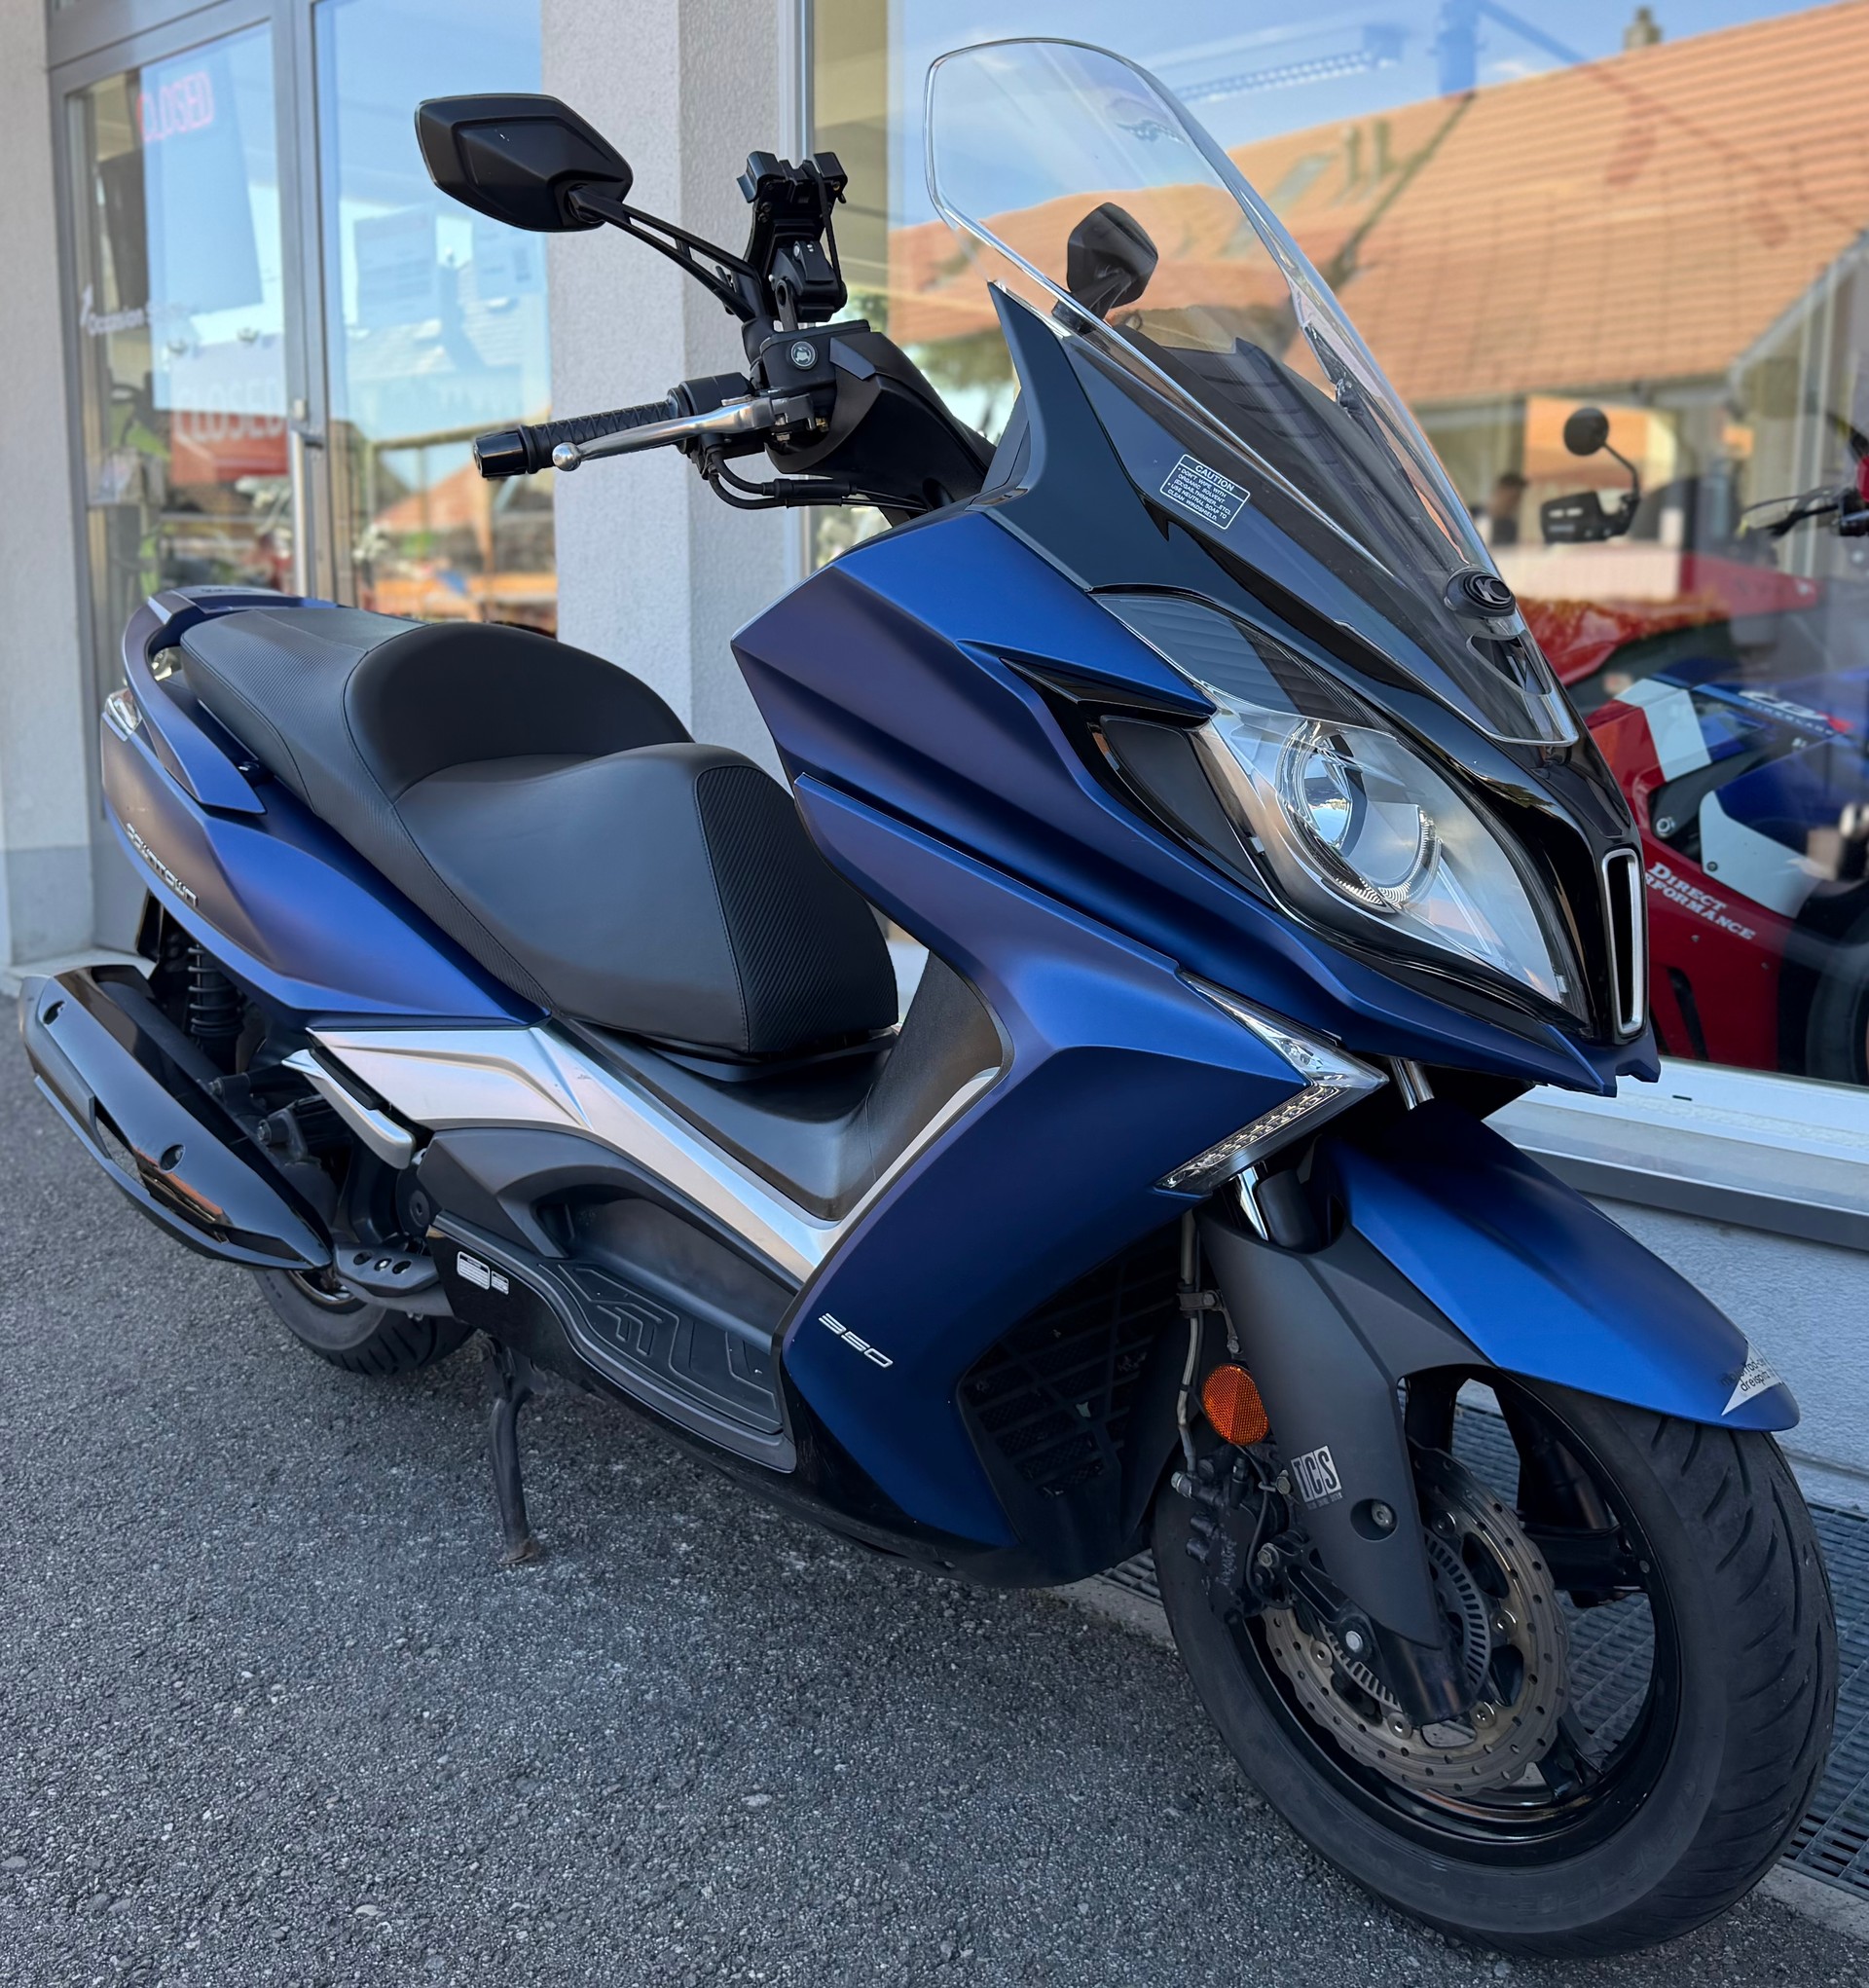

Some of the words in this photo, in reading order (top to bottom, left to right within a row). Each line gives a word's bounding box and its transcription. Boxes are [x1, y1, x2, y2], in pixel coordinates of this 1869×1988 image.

[136, 72, 214, 142] CLOSED
[173, 377, 282, 443] CLOSED
[1167, 490, 1185, 500] CLEAN
[1178, 474, 1201, 490] ORGANIC
[1202, 489, 1225, 503] SOLVENT
[1182, 469, 1197, 480] DON'T
[1198, 479, 1212, 489] WIPE
[1213, 488, 1227, 497] WITH
[1195, 465, 1234, 491] CAUTION
[1171, 484, 1183, 493] USE
[1183, 491, 1204, 506] NEUTRAL
[1205, 504, 1219, 514] SOAP
[1647, 862, 1728, 911] DIRECT
[818, 1312, 894, 1369] 350
[1293, 1451, 1338, 1499] TCS
